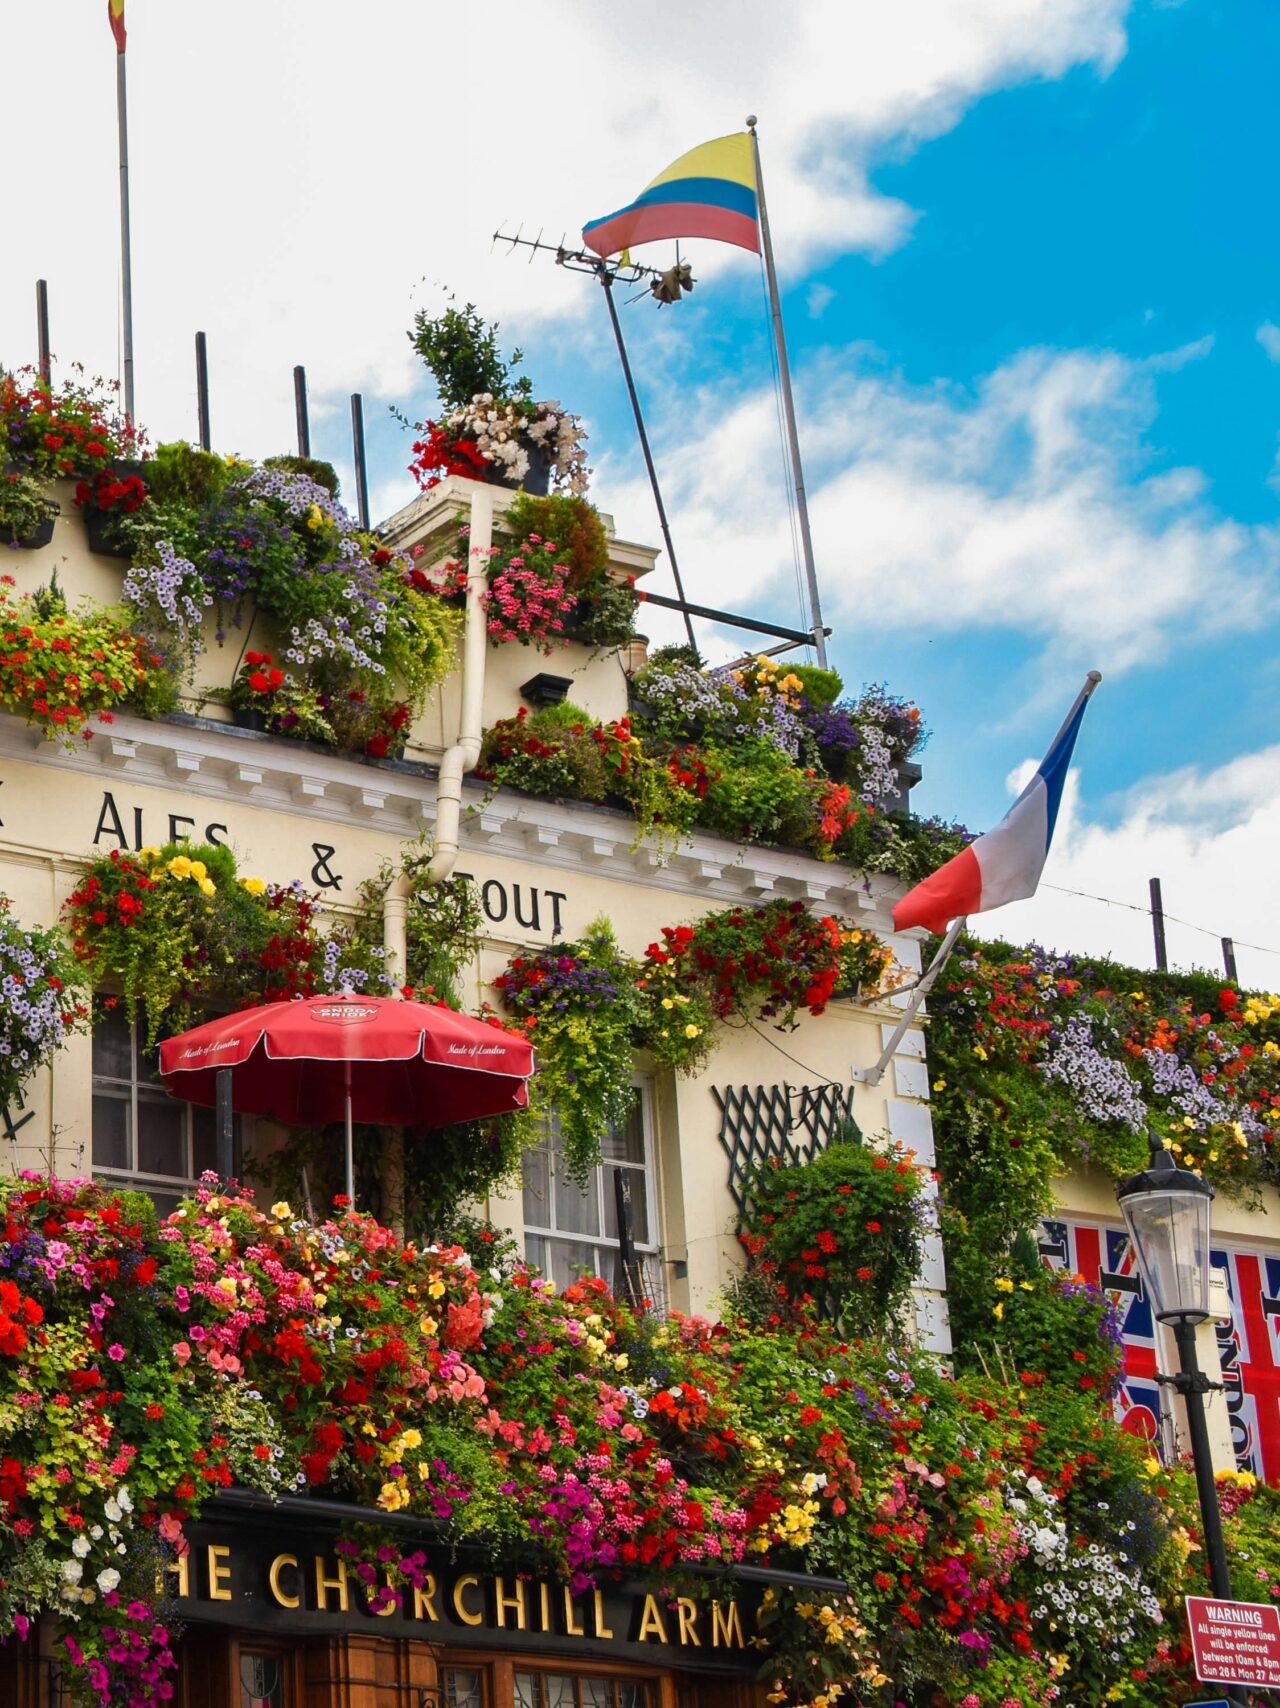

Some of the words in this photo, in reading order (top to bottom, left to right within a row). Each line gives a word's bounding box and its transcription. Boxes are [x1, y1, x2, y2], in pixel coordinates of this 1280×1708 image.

[311, 843, 343, 891] &
[447, 1043, 468, 1054] Made
[477, 1044, 506, 1055] London
[638, 1592, 770, 1649] ARM
[1206, 1606, 1262, 1625] WARNING
[1198, 1623, 1209, 1634] All
[1210, 1625, 1232, 1637] single
[1233, 1628, 1257, 1639] yellow
[1258, 1630, 1276, 1641] lines
[1210, 1639, 1224, 1649] will
[1225, 1640, 1234, 1650] be
[1236, 1641, 1268, 1654] enforced
[1202, 1651, 1234, 1663] between
[1235, 1654, 1255, 1665] 10am
[1256, 1657, 1262, 1666] &
[1263, 1657, 1280, 1668] 8pm
[1202, 1664, 1217, 1675] Sun
[1219, 1666, 1229, 1677] 26
[1230, 1667, 1236, 1677] &
[1238, 1668, 1254, 1679] Mon
[1255, 1670, 1266, 1680] 27
